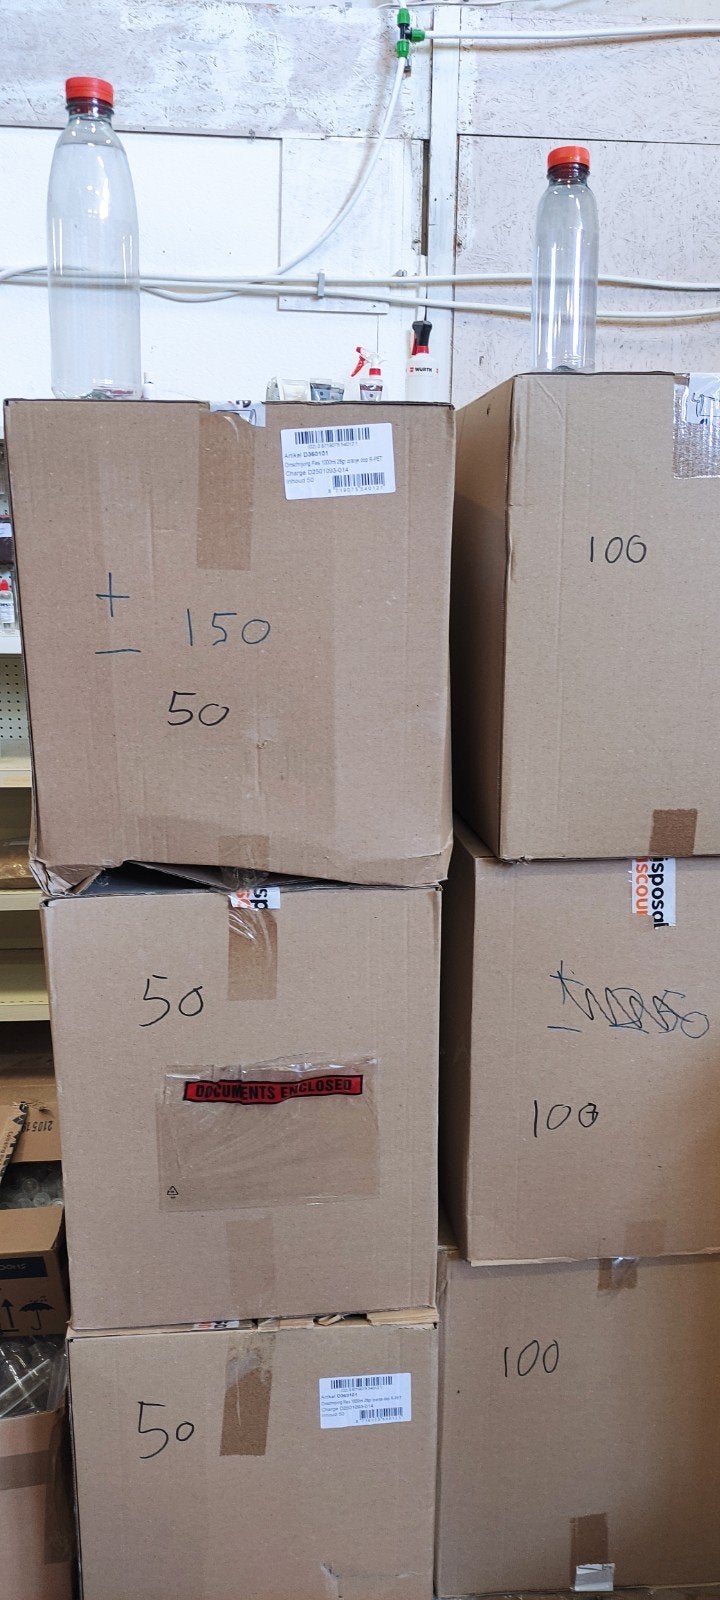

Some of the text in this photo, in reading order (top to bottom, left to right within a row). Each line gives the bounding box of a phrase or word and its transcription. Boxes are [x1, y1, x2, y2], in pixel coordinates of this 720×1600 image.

[286, 470, 306, 478] Charge
[186, 608, 270, 646] 150
[167, 690, 230, 726] 50
[139, 974, 204, 1027] 50
[195, 1078, 353, 1100] DOCUMENTS ENCLOSED
[504, 1339, 559, 1377] 100
[138, 1401, 194, 1459] 50
